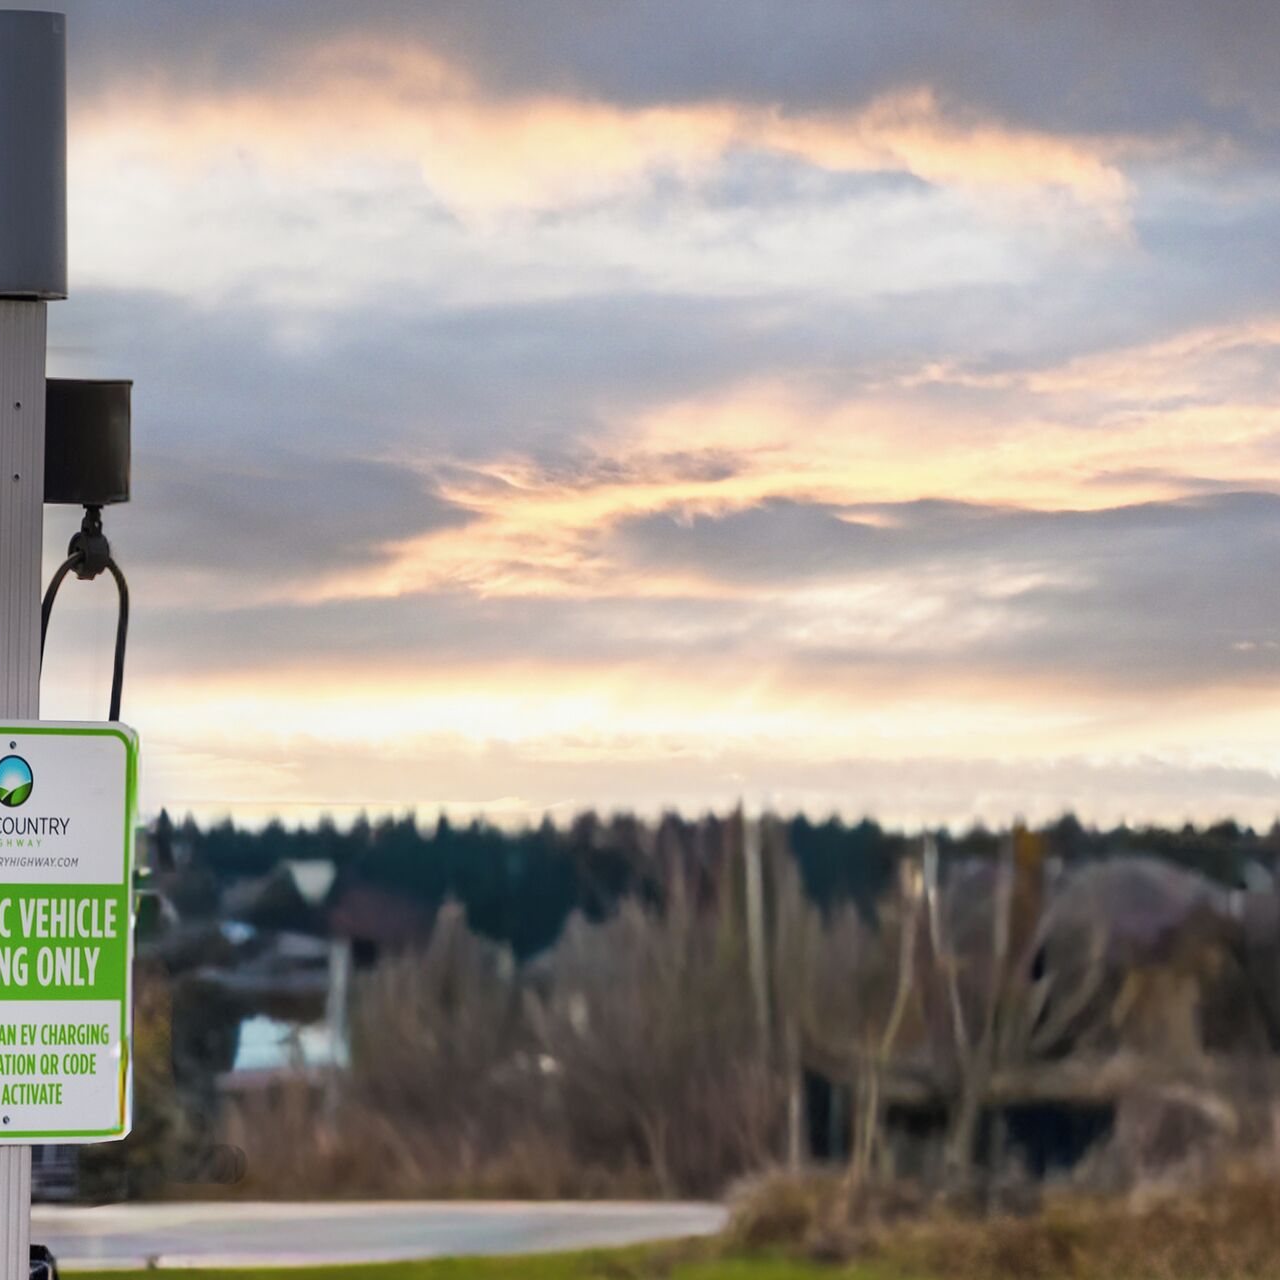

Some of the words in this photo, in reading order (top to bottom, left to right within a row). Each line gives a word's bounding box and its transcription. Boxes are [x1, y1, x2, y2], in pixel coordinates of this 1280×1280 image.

[19, 898, 117, 938] VEHICLE
[37, 946, 101, 986] ONLY
[21, 1024, 37, 1045] EV
[41, 1024, 110, 1045] CHARGING
[39, 1054, 58, 1076] QR
[61, 1054, 96, 1075] CODE
[1, 1083, 63, 1105] ACTIVATE
